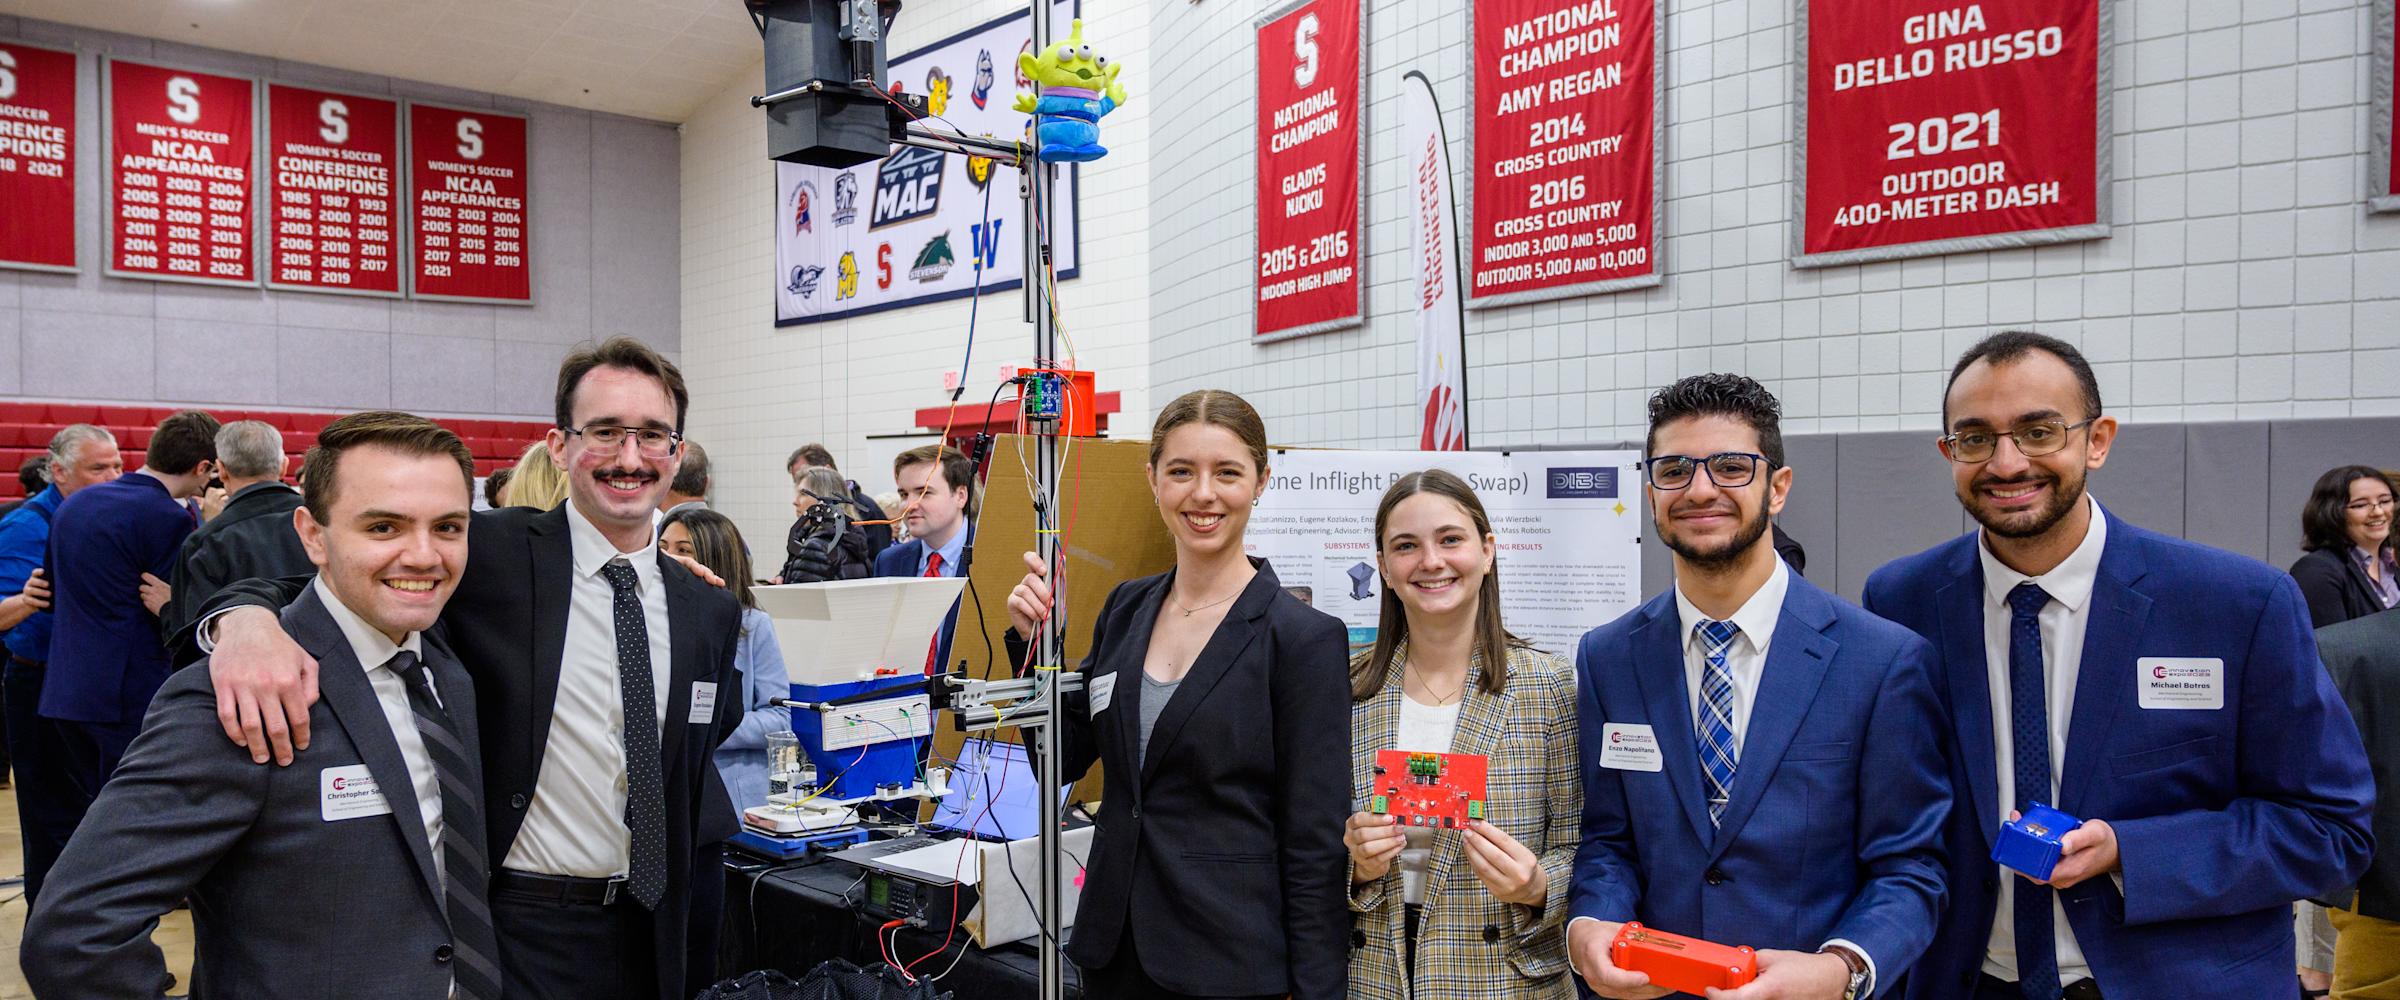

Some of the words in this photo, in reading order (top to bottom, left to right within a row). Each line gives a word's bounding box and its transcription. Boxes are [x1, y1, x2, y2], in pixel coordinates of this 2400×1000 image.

[1503, 0, 1617, 50] NATIONAL
[1903, 4, 1987, 45] GINA
[1294, 11, 1320, 89] S
[1499, 23, 1620, 78] CHAMPION
[1834, 48, 1934, 92] DELLO
[1944, 26, 2063, 73] RUSSO
[166, 76, 200, 123] S
[1497, 83, 1545, 116] AMY
[1549, 62, 1622, 103] REGAN
[1274, 87, 1337, 130] NATIONAL
[319, 99, 349, 143] S
[1271, 110, 1338, 154] CHAMPION
[1530, 112, 1586, 148] 2014
[136, 122, 178, 138] MEN'S
[181, 128, 229, 145] SOCCER
[456, 118, 484, 160] S
[1887, 108, 2001, 161] 2021
[152, 140, 214, 163] NCAA
[286, 143, 339, 159] WOMEN'S
[341, 149, 382, 163] SOCCER
[1494, 151, 1544, 178] CROSS
[1548, 134, 1622, 167] COUNTRY
[28, 160, 63, 177] 2021
[122, 154, 244, 181] APPEARANCES
[278, 156, 388, 181] CONFERENCE
[428, 160, 476, 175] WOMEN'S
[477, 165, 514, 178] SOCCER
[1282, 163, 1326, 196] GLADYS
[1882, 160, 2005, 198] OUTDOOR
[123, 172, 157, 187] 2001
[166, 177, 201, 192] 2003
[208, 181, 244, 197] 2004
[278, 172, 388, 196] CHAMPIONS
[445, 175, 496, 195] NCAA
[1529, 175, 1585, 209] 2016
[122, 189, 158, 204] 2005
[166, 193, 201, 208] 2006
[209, 197, 243, 212] 2007
[280, 190, 312, 204] 1985
[320, 194, 350, 208] 1987
[359, 198, 387, 212] 1993
[421, 189, 521, 210] APPEARANCES
[874, 173, 940, 223] MAC
[1286, 189, 1323, 219] NJOKU
[1834, 190, 1978, 228] 400-METER
[1985, 181, 2060, 211] DASH
[122, 205, 159, 220] 2008
[166, 209, 201, 224] 2009
[210, 213, 242, 228] 2010
[280, 206, 312, 220] 1996
[319, 210, 351, 223] 2000
[358, 213, 387, 226] 2001
[421, 205, 451, 218] 2002
[457, 208, 486, 221] 2003
[492, 211, 521, 224] 2004
[1426, 132, 1444, 301] ENGINEERING
[1494, 213, 1544, 239] CROSS
[1547, 200, 1622, 229] COUNTRY
[126, 221, 156, 236] 2011
[168, 225, 200, 240] 2012
[211, 229, 242, 244] 2013
[279, 221, 313, 236] 2003
[319, 225, 351, 238] 2004
[358, 229, 389, 242] 2005
[421, 220, 452, 233] 2005
[457, 223, 487, 236] 2006
[493, 226, 520, 239] 2010
[124, 238, 157, 253] 2014
[168, 241, 200, 256] 2015
[211, 245, 242, 259] 2017
[279, 237, 313, 251] 2006
[321, 240, 350, 254] 2010
[361, 244, 386, 257] 2011
[425, 235, 449, 247] 2011
[459, 237, 485, 250] 2015
[494, 240, 520, 252] 2016
[971, 218, 1003, 271] W
[1261, 245, 1297, 277] 2015
[1299, 248, 1308, 268] &
[1310, 231, 1349, 265] 2016
[1484, 239, 1530, 264] INDOOR
[1532, 233, 1568, 257] 3,000
[1571, 232, 1593, 248] AND
[1596, 223, 1637, 247] 5,000
[124, 253, 158, 269] 2018
[168, 257, 200, 272] 2021
[209, 261, 244, 276] 2022
[281, 253, 312, 266] 2015
[321, 256, 351, 269] 2016
[360, 259, 388, 272] 2017
[424, 249, 450, 262] 2017
[459, 252, 486, 264] 2018
[494, 255, 520, 267] 2019
[877, 242, 892, 289] S
[1476, 262, 1532, 288] OUTDOOR
[1534, 257, 1572, 280] 5,000
[1574, 255, 1597, 272] AND
[1600, 247, 1647, 271] 10,000
[281, 268, 312, 282] 2018
[321, 271, 351, 284] 2019
[424, 264, 451, 277] 2021
[1260, 279, 1297, 302] INDOOR
[1297, 273, 1321, 293] HIGH
[1321, 266, 1352, 288] JUMP
[1310, 471, 1382, 495] Inflight
[1468, 471, 1529, 496] Swap)
[1552, 473, 1613, 489] DIBS
[1289, 527, 1333, 536] Engineering;
[1334, 527, 1362, 535] Advisor:
[1299, 516, 1325, 524] Eugene
[1501, 527, 1520, 535] Mass
[1521, 526, 1551, 535] Robotics
[1324, 542, 1370, 550] SUBSYSTEMS
[1511, 543, 1543, 551] RESULTS
[1624, 746, 1655, 754] Napolitano
[328, 791, 369, 800] Christopher
